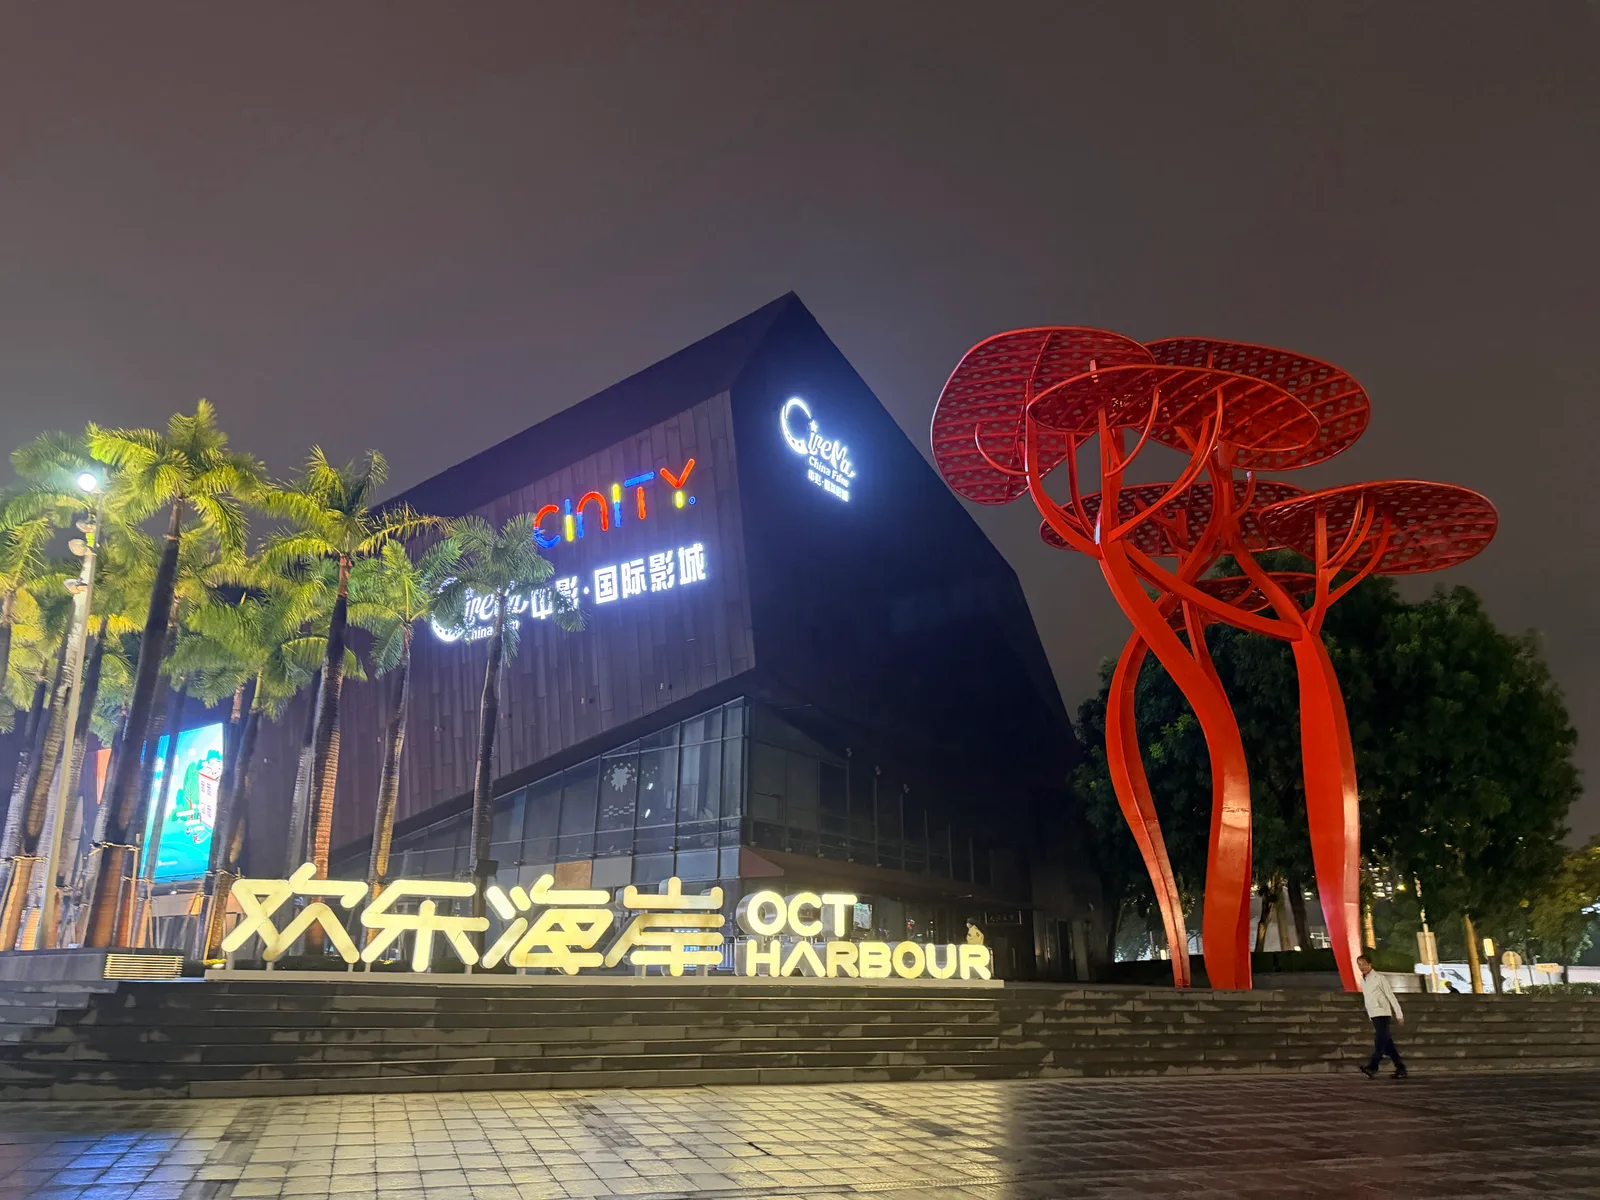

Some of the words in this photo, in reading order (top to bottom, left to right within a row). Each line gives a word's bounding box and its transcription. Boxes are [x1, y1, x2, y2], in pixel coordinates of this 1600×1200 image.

[808, 455, 831, 477] China
[220, 862, 726, 977] 欢乐海岸
[746, 890, 858, 937] OCT
[745, 939, 992, 981] HARBOUR
